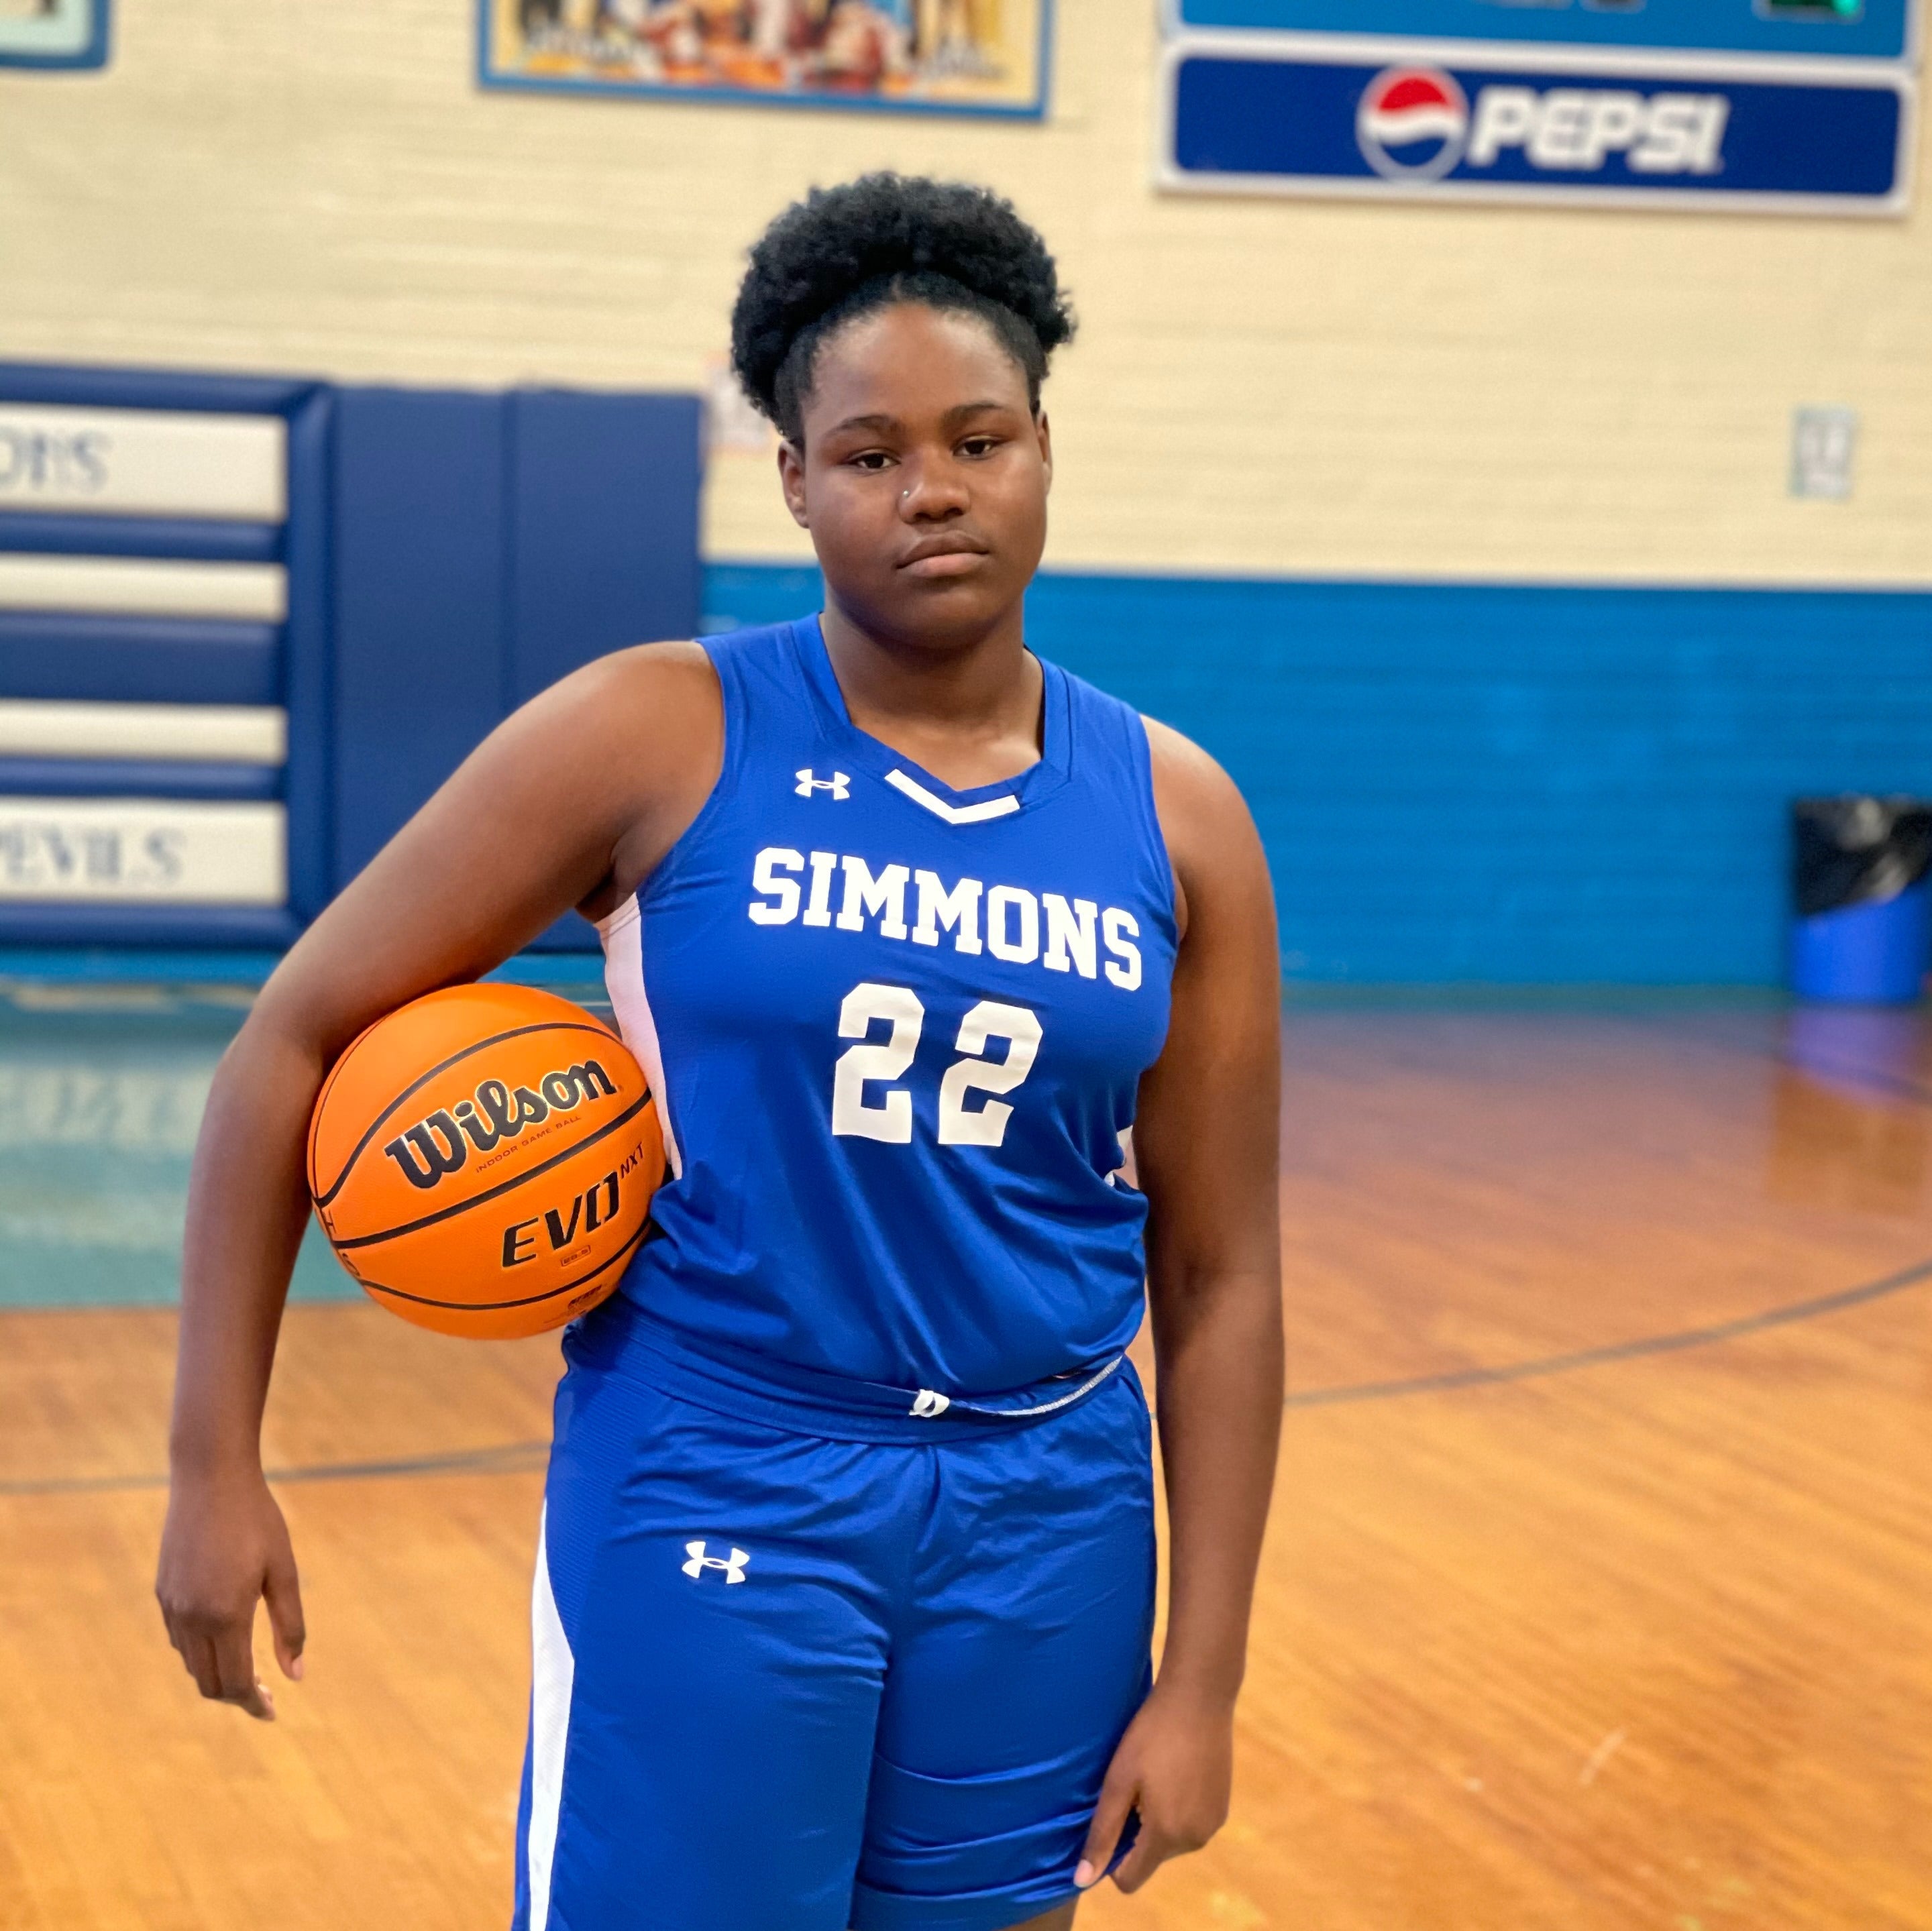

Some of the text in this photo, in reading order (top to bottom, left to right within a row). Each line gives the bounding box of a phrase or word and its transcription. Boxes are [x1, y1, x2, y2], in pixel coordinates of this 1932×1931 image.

[1466, 87, 1728, 174] PEPSI
[748, 846, 1142, 991] SIMMONS
[384, 1060, 617, 1189] Wilson
[831, 983, 1044, 1147] 22
[476, 1115, 582, 1173] INDOOR GAME BALL
[502, 1142, 644, 1268] EVO NXT
